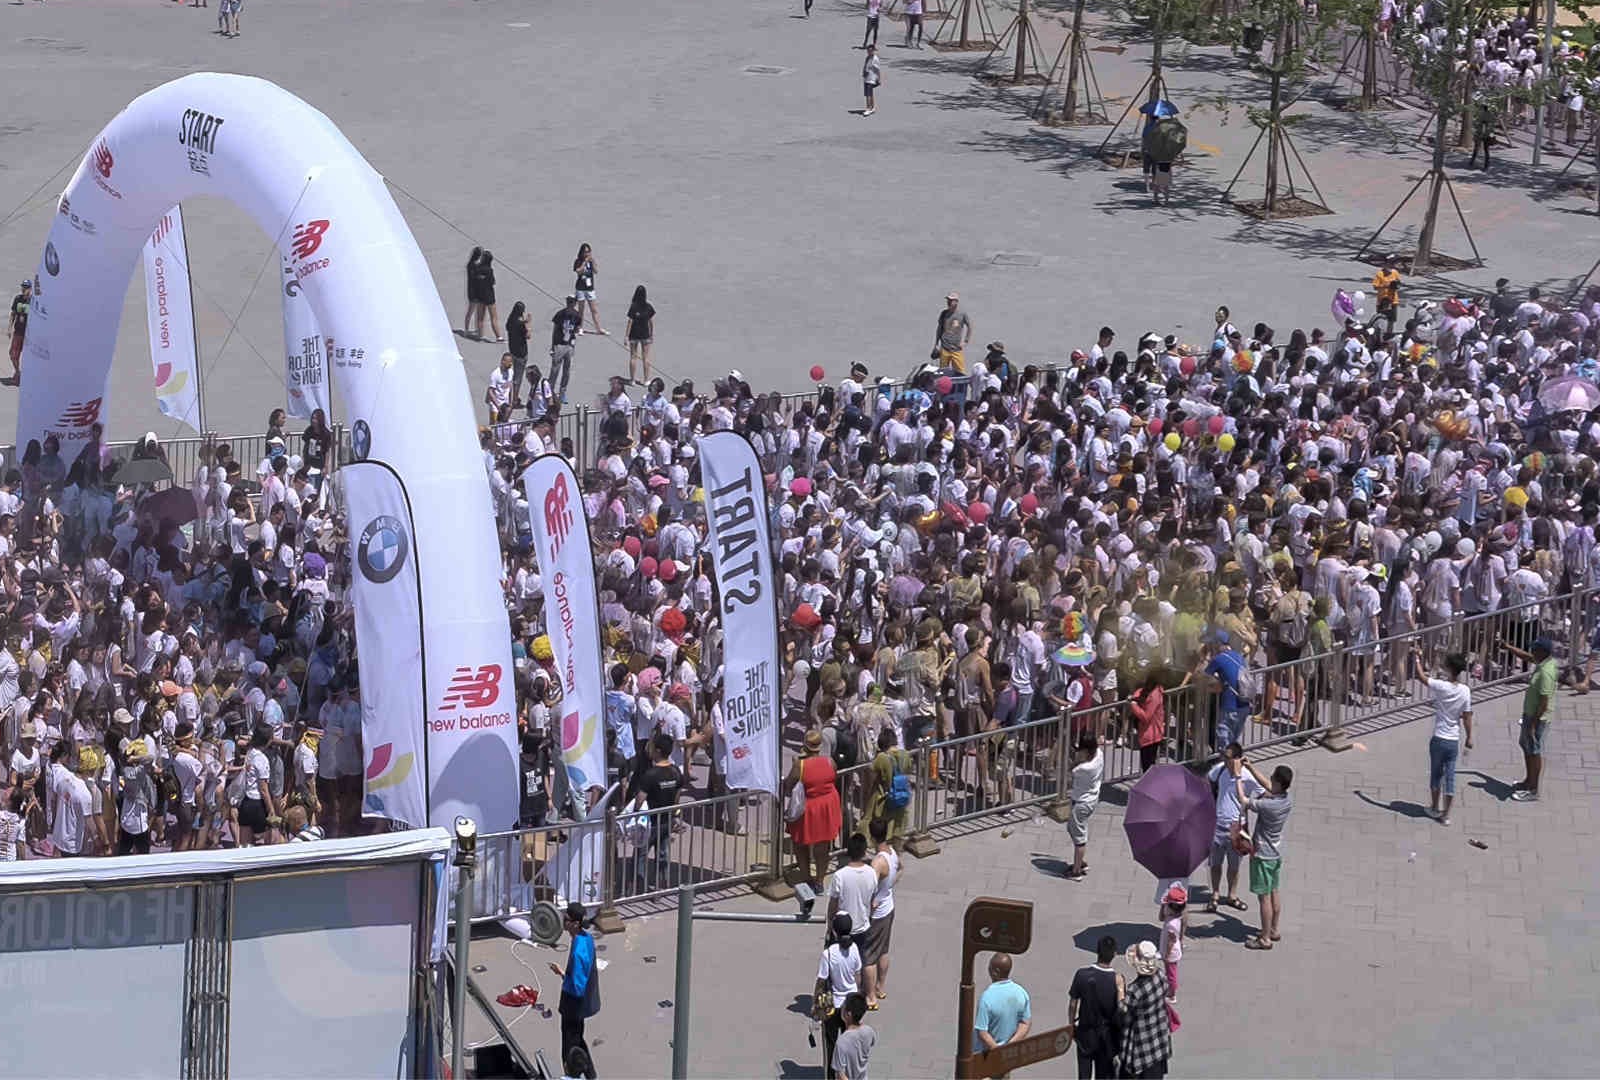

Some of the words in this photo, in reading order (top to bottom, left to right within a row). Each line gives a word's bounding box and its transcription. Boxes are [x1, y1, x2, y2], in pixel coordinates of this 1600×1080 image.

[179, 108, 224, 155] START
[426, 716, 455, 732] new
[459, 711, 511, 731] balance
